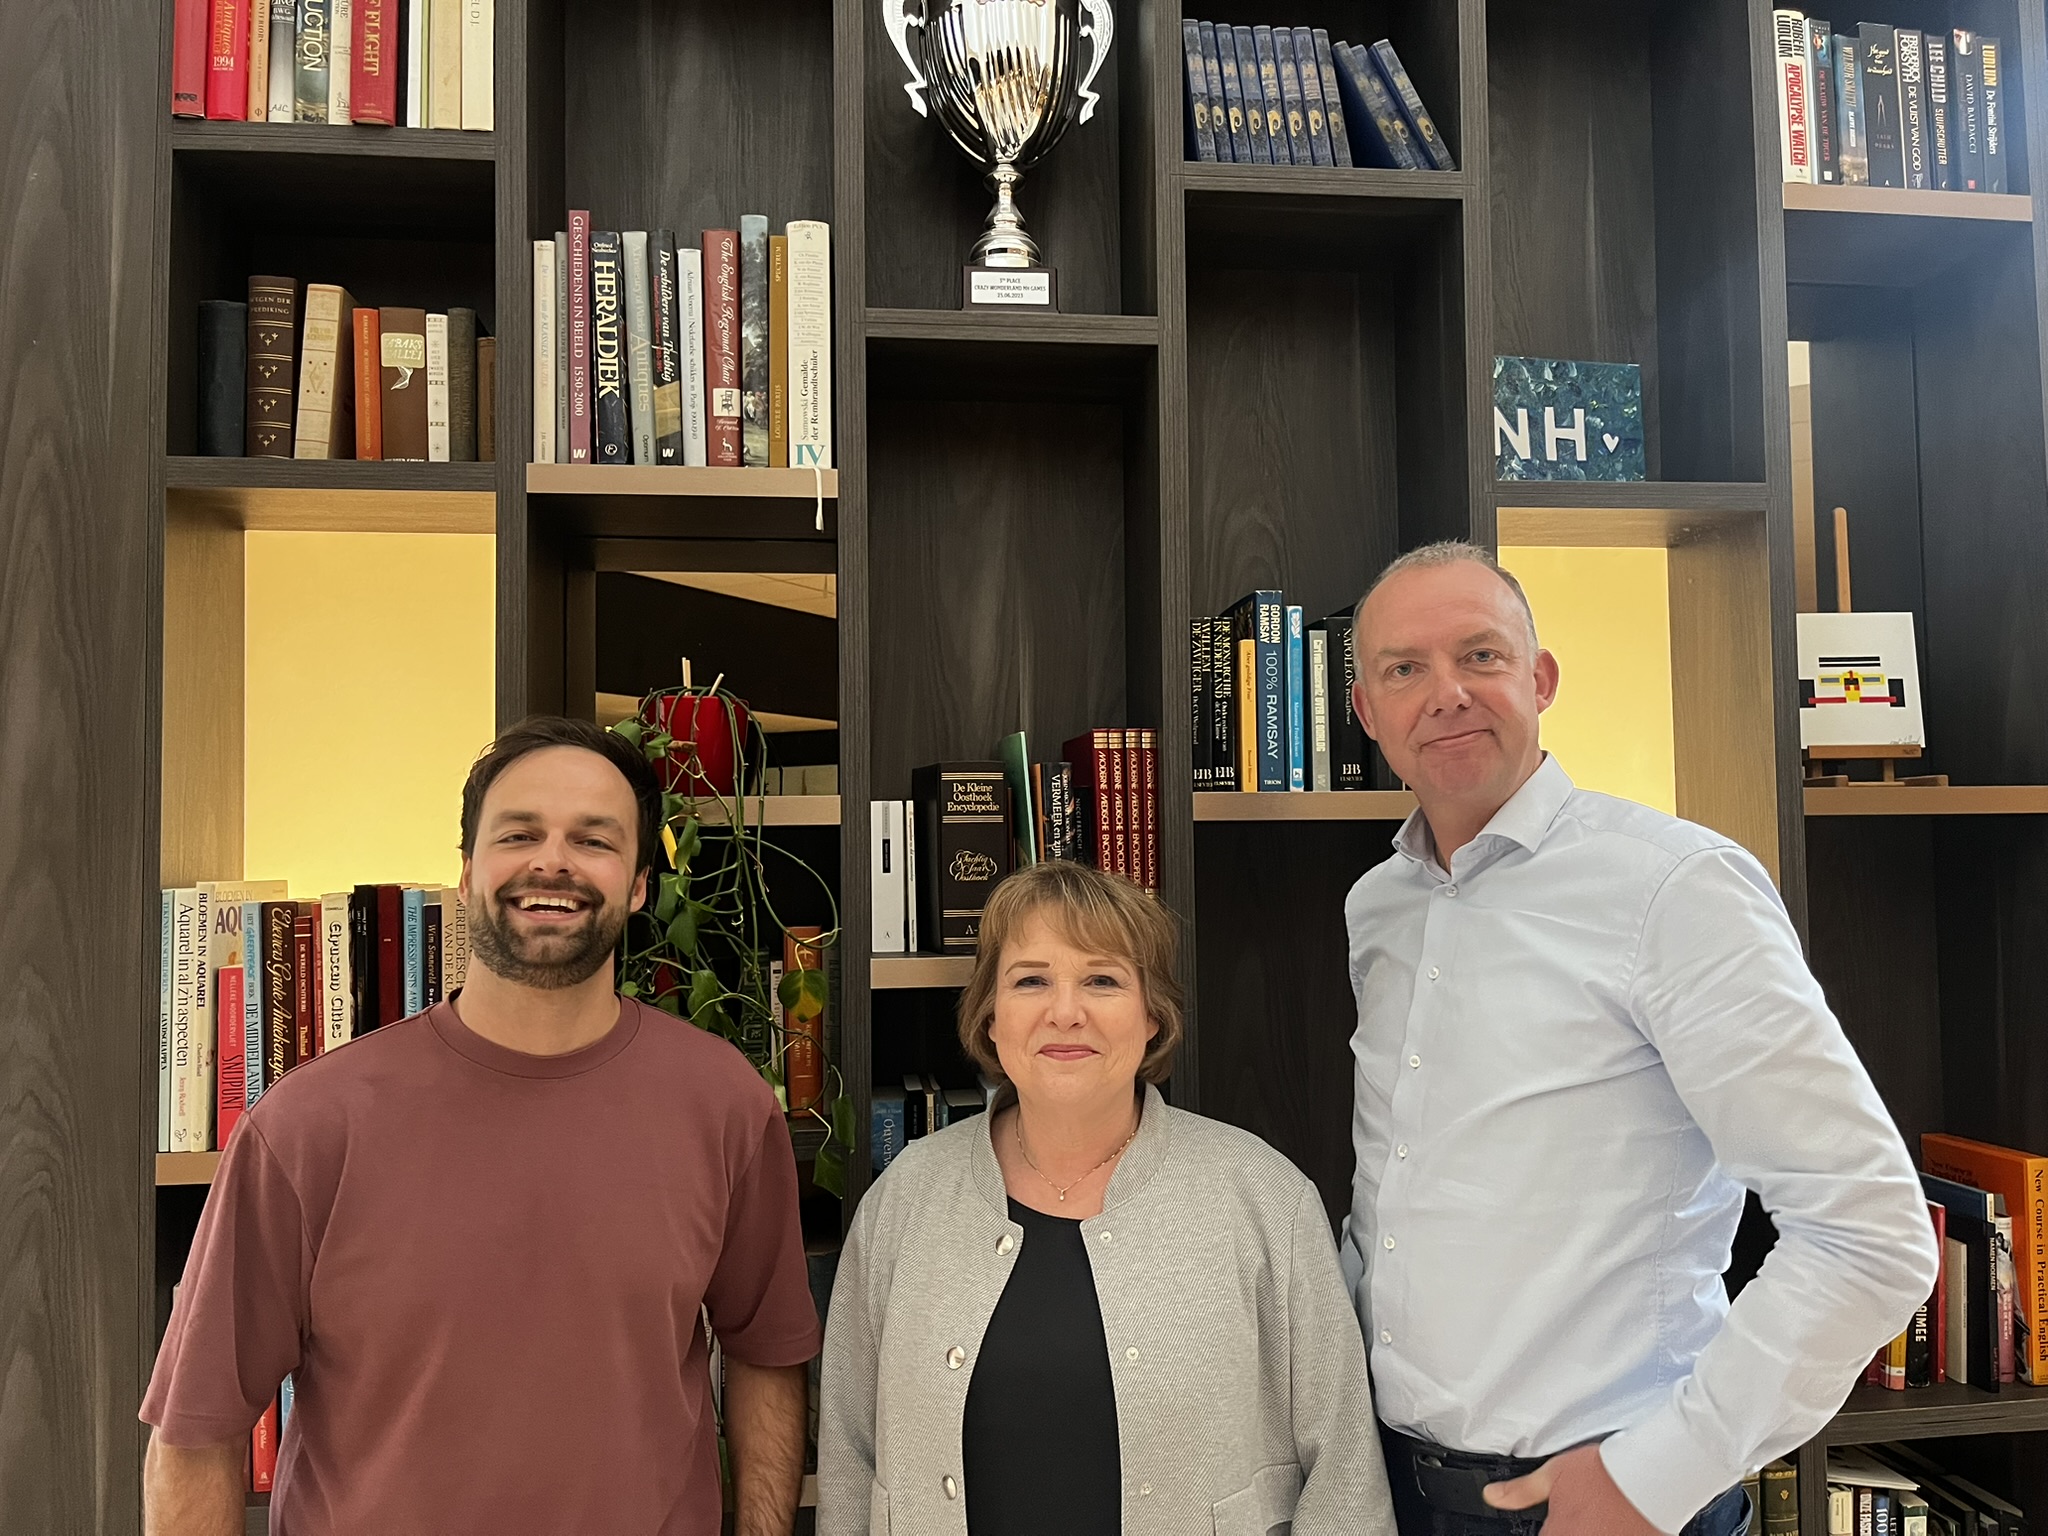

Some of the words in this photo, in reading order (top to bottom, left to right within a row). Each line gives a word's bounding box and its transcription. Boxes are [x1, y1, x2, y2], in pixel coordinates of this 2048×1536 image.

[222, 1, 237, 56] Antiques
[363, 10, 382, 77] FLIGHT
[1776, 14, 1793, 58] LUDLUM
[1791, 18, 1804, 59] ROBERT
[213, 56, 234, 68] 1994
[1842, 46, 1855, 80] WILBUR
[1899, 34, 1912, 83] FORSYTH
[1908, 35, 1921, 83] FREDERICK
[1927, 43, 1944, 63] LEE
[1981, 44, 1998, 87] LUDLUM
[1787, 63, 1805, 127] APOCALYPSE
[1844, 79, 1857, 108] SMITH
[1908, 86, 1917, 98] DE
[1929, 64, 1947, 104] CHILD
[1965, 74, 1974, 105] DAVID
[1986, 90, 1996, 101] De
[1909, 100, 1918, 127] VUIST
[1967, 107, 1977, 154] BALDACCI
[1986, 102, 1997, 126] Fontini
[1791, 129, 1806, 166] WATCH
[1911, 127, 1920, 148] VAN
[1934, 108, 1947, 165] SLUIPSCHUTTER
[1987, 127, 1998, 155] Strijders
[1913, 147, 1922, 171] GOD
[572, 216, 584, 304] GESCHIEDENIS
[659, 249, 671, 266] De
[720, 237, 734, 263] The
[774, 246, 782, 282] SPECTRUM
[660, 266, 674, 316] schilders
[717, 263, 735, 302] English
[573, 305, 583, 318] IN
[592, 258, 620, 399] HERALDIEK
[635, 305, 645, 333] World
[662, 316, 671, 339] van
[717, 303, 735, 354] Regional
[541, 321, 549, 359] KLASSIEKE
[573, 319, 584, 358] BEELD
[630, 333, 651, 412] Antiques
[722, 355, 735, 386] Chair
[574, 365, 585, 416] 1550-2000
[689, 392, 698, 410] Parijs
[774, 384, 783, 409] PARIJS
[774, 409, 783, 440] LOUVRE
[800, 398, 809, 441] Sumowski
[810, 426, 819, 441] der
[1493, 406, 1588, 462] NH
[641, 434, 650, 463] Optimum
[795, 443, 826, 466] IV
[1191, 622, 1201, 637] DE
[1213, 621, 1223, 632] IN
[1222, 621, 1231, 636] DE
[1259, 603, 1270, 644] RAMSAY
[1270, 604, 1281, 643] GORDON
[1202, 621, 1211, 673] WILLEM
[1313, 639, 1323, 651] Carl
[1314, 652, 1323, 664] von
[1343, 628, 1353, 687] NAPOLEON
[1191, 640, 1202, 693] ZWIJGER
[1213, 634, 1223, 699] NEDERLAND
[1222, 636, 1232, 698] MONARCHIE
[1265, 650, 1278, 690] 100%
[1313, 664, 1324, 696] Clausewitz
[1315, 697, 1325, 715] OVER
[1315, 715, 1326, 724] DE
[1266, 694, 1279, 759] RAMSAY
[1316, 724, 1326, 752] OORLOG
[953, 782, 966, 793] De
[966, 782, 993, 793] Kleine
[1098, 749, 1107, 790] MODERNE
[1113, 749, 1122, 790] MODERNE
[1130, 749, 1138, 790] MODERNE
[1146, 749, 1155, 790] MODERNE
[946, 802, 1000, 813] Encyclopedie
[953, 792, 993, 802] Oosthoek
[1050, 774, 1063, 827] VERMEER
[1099, 791, 1109, 831] MEDISCHE
[1114, 791, 1124, 831] MEDISCHE
[1131, 791, 1140, 831] MEDISCHE
[1147, 791, 1157, 831] MEDISCHE
[1050, 839, 1064, 858] zijn
[1053, 827, 1061, 839] en
[1148, 833, 1159, 887] ENCYCLOPEDIE
[178, 902, 194, 955] Aquarel
[198, 892, 208, 943] BLOEMEN
[246, 913, 254, 927] HET
[407, 905, 417, 922] THE
[197, 945, 207, 956] IN
[270, 907, 291, 961] Elseviers
[299, 943, 307, 953] DE
[427, 923, 437, 943] Wim
[445, 922, 453, 949] VAN
[178, 958, 193, 971] in
[245, 926, 256, 980] GREENPEACE
[299, 953, 307, 978] WERELD
[328, 921, 343, 991] Etruscan
[407, 924, 417, 988] IMPRESSIONISTS
[428, 945, 437, 984] Sonneveld
[445, 953, 453, 971] DE
[177, 987, 192, 1006] z'n
[178, 973, 193, 985] al
[196, 959, 207, 1010] AQUAREL
[266, 960, 292, 1001] Grote
[429, 988, 435, 996] De
[245, 1003, 258, 1019] DE
[330, 994, 344, 1039] Cities
[408, 989, 417, 1008] AND
[160, 1012, 168, 1071] LANDSCHAPPEN
[175, 1008, 192, 1067] aspecten
[229, 1002, 237, 1047] NOORDERVLIET
[299, 1025, 309, 1056] Thailand
[221, 1055, 244, 1111] SNIJPUNT
[2034, 1169, 2044, 1193] New
[2035, 1198, 2046, 1240] Course
[2036, 1243, 2046, 1256] in
[2037, 1260, 2048, 1314] Practical
[2037, 1312, 2048, 1362] English
[1875, 1508, 1888, 1533] 100
